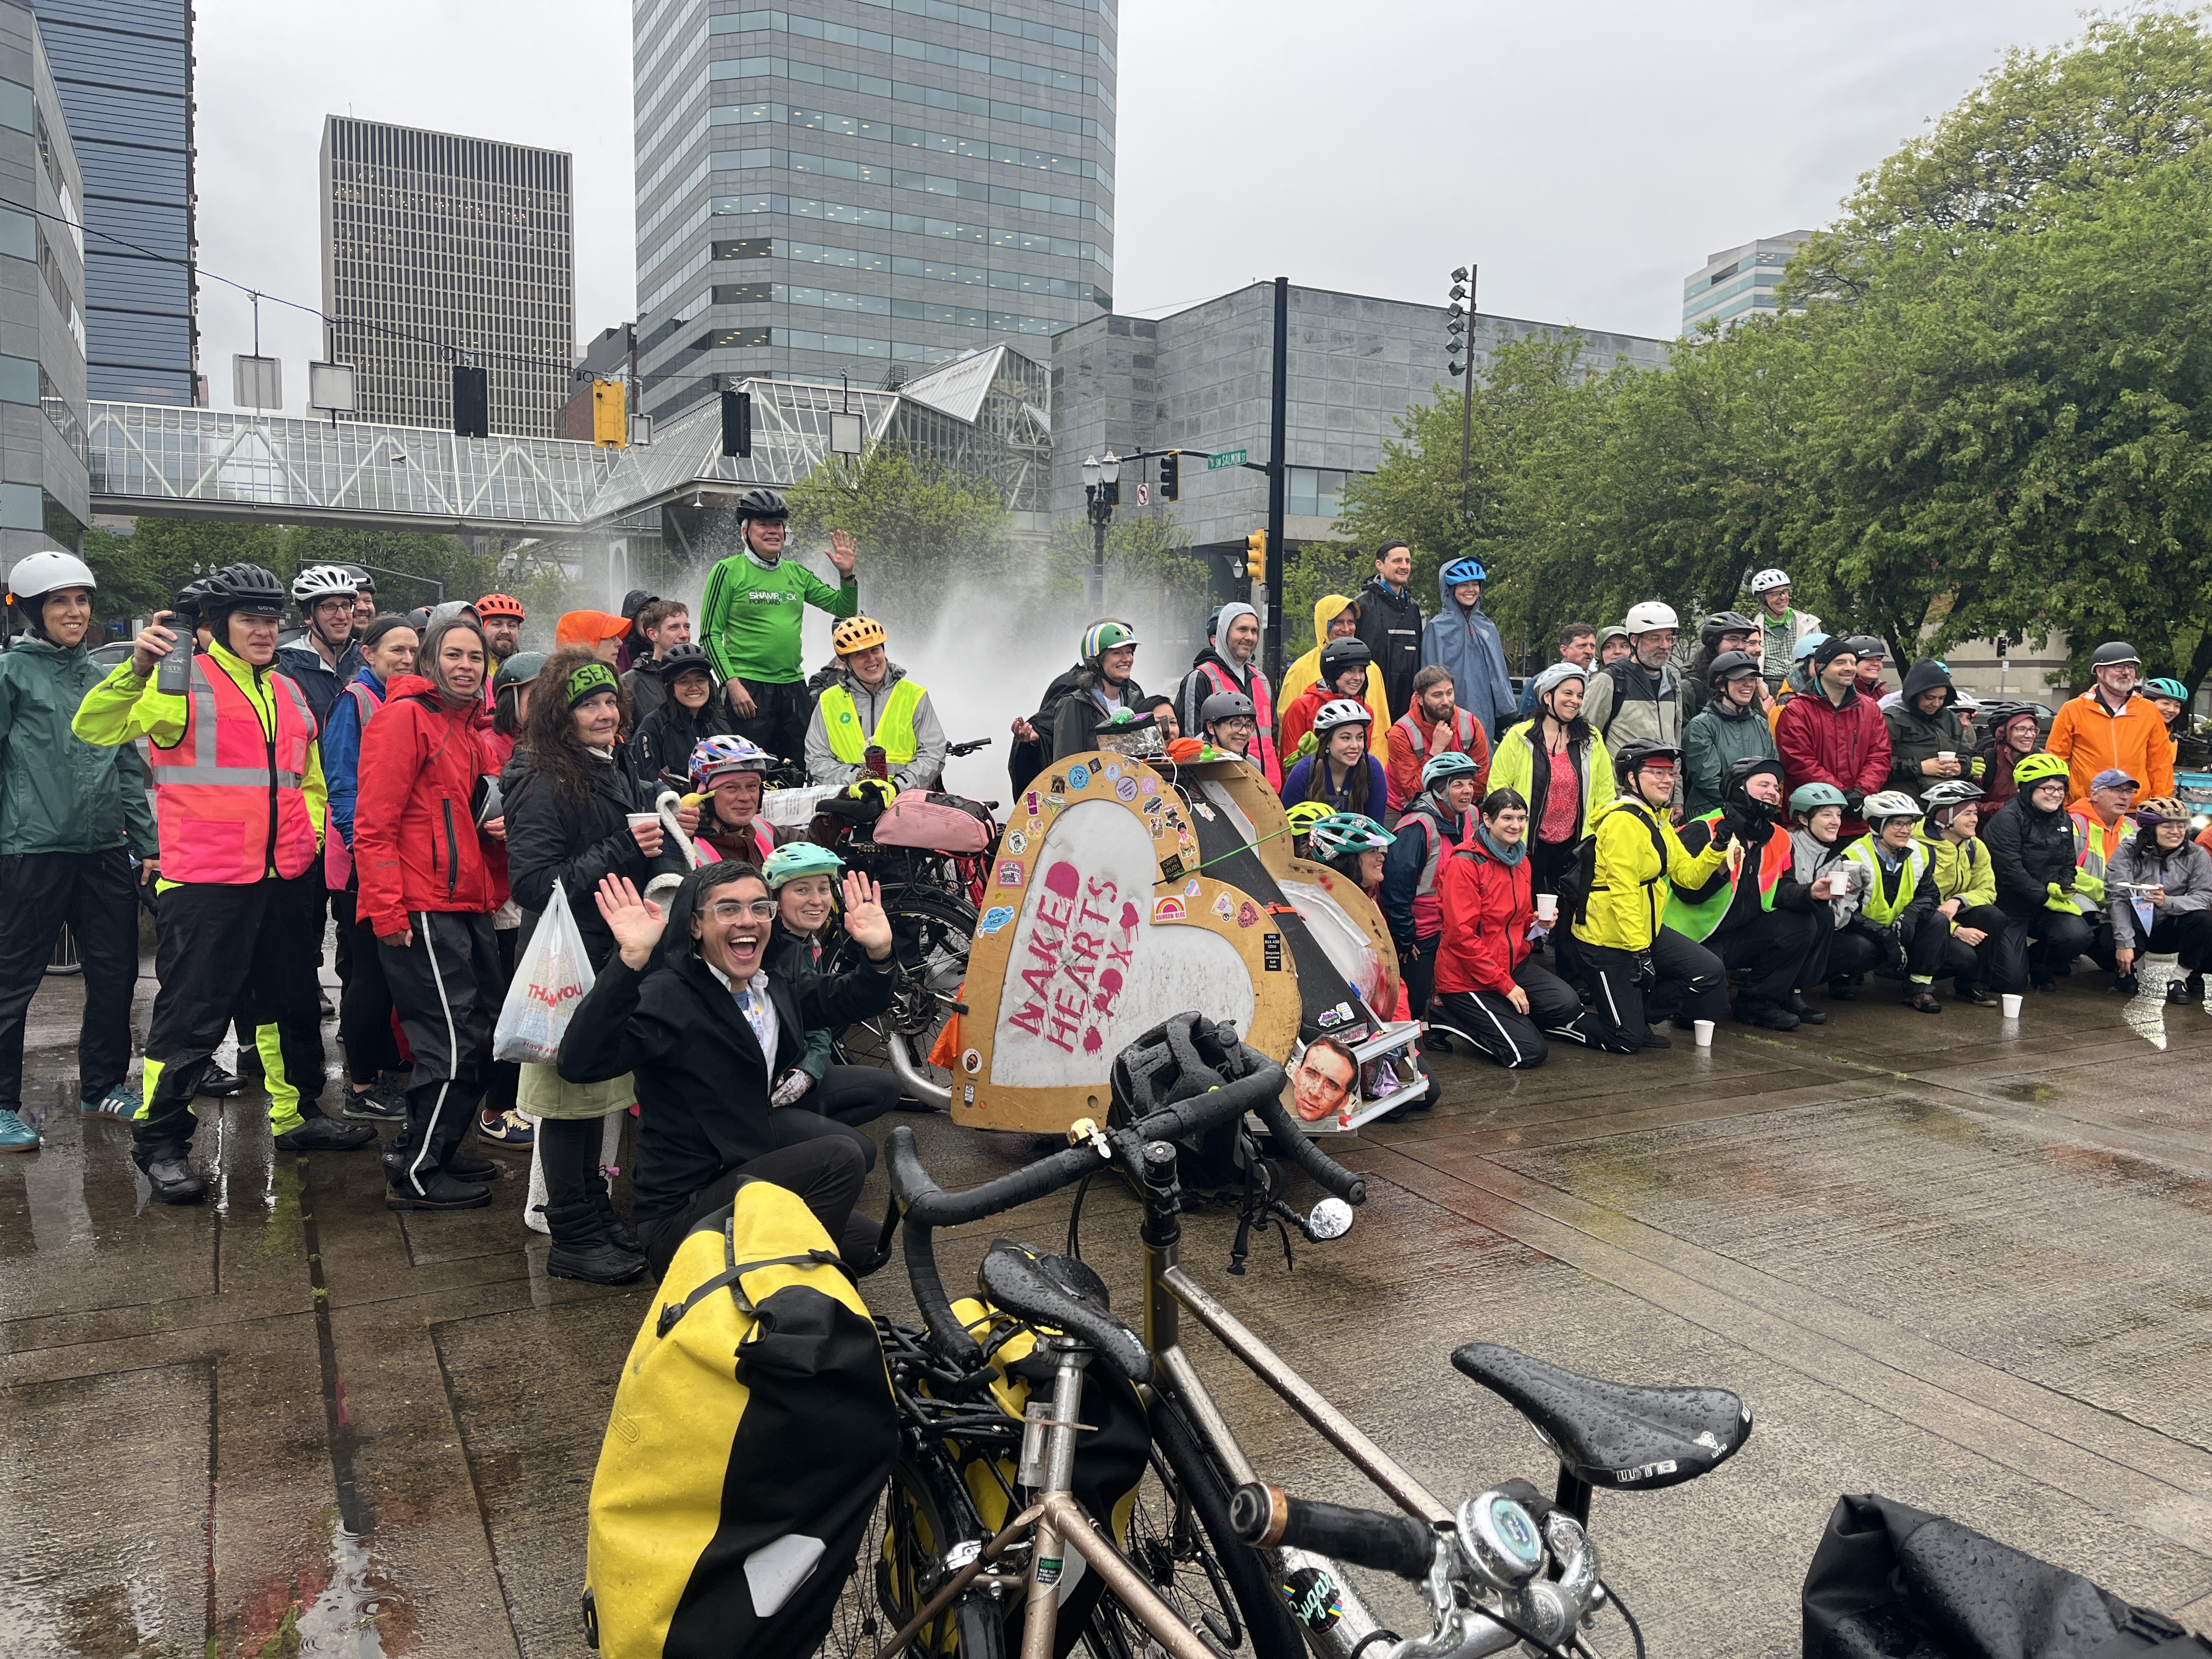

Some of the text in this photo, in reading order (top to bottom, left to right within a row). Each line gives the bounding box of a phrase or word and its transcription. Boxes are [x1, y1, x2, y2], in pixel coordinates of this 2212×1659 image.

[1215, 452, 1246, 467] SW SALMON ST
[749, 592, 797, 601] SHAMRCK
[1163, 856, 1177, 868] CARS
[1166, 863, 1180, 874] RUIN
[1047, 876, 1118, 1053] HEARTS
[557, 982, 583, 1001] YOU
[523, 1041, 543, 1051] Have
[1711, 1443, 1728, 1458] WTB
[1616, 1459, 1678, 1482] WTB
[1288, 1571, 1338, 1627] Sugar
